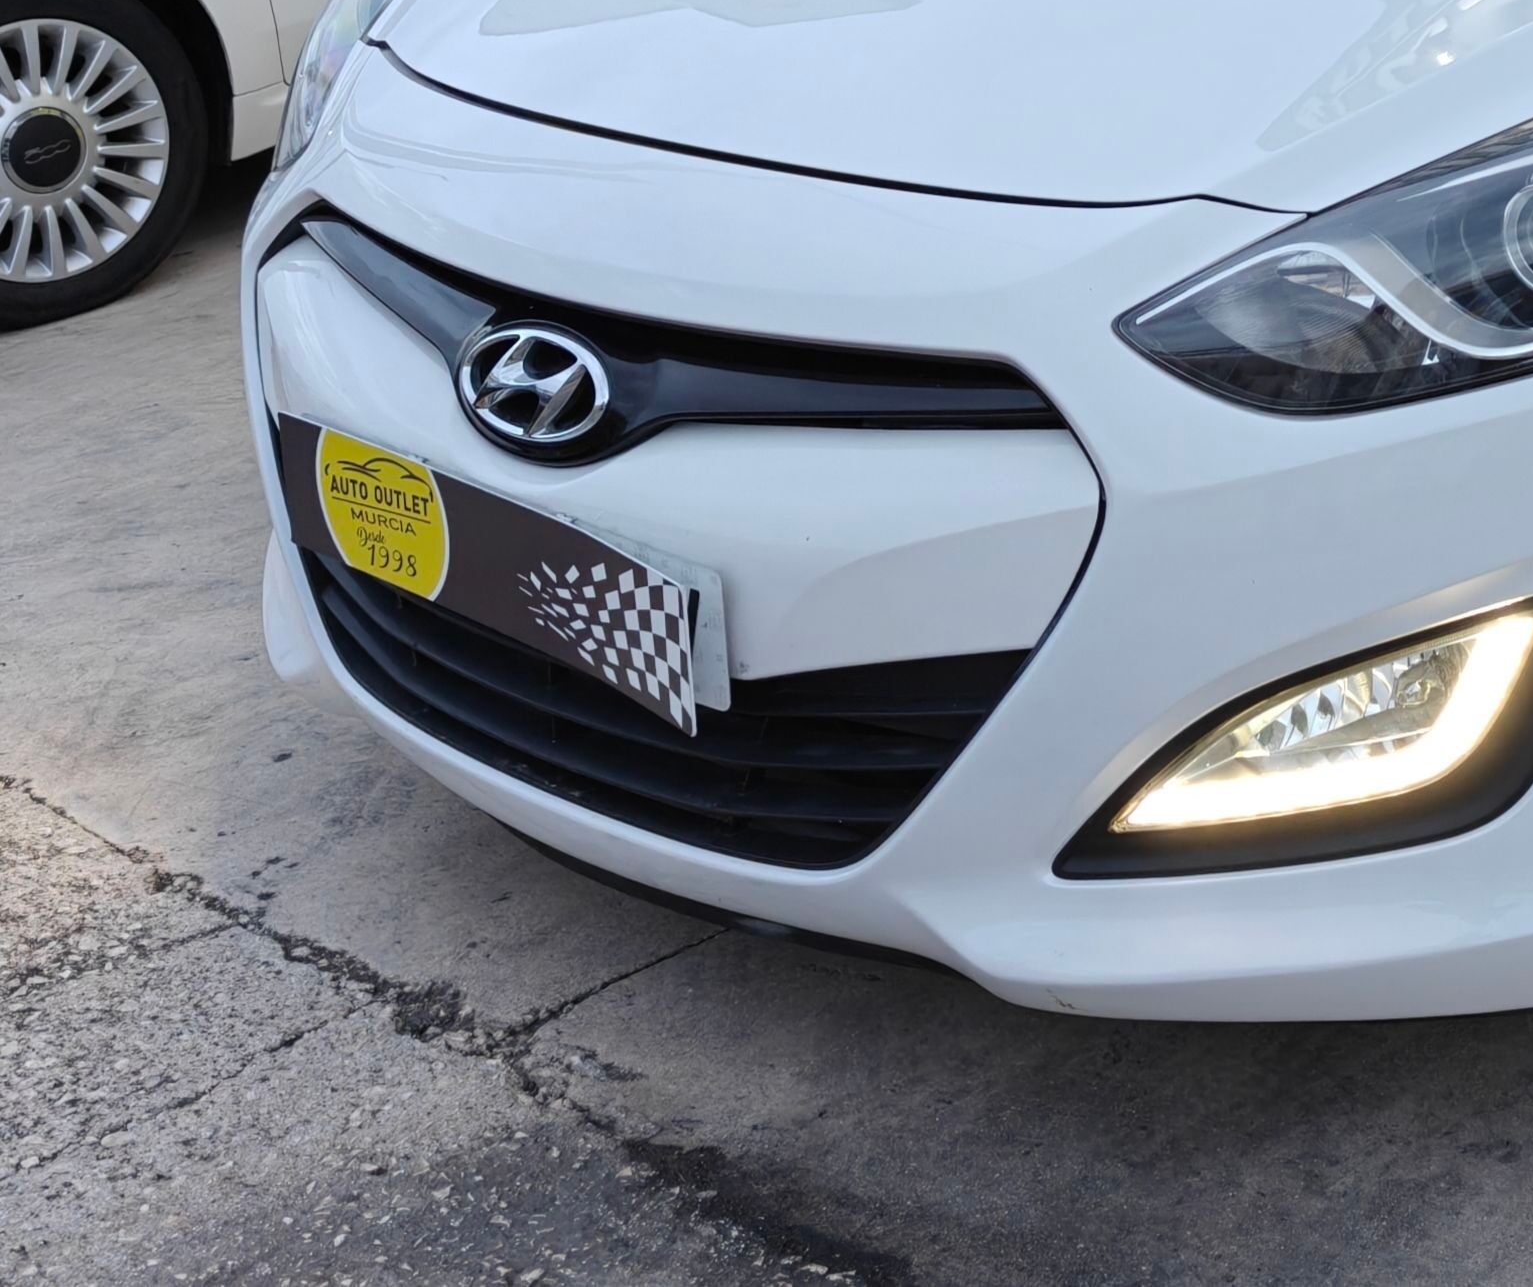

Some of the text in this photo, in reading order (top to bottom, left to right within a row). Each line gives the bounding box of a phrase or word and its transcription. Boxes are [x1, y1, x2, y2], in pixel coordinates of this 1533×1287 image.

[330, 474, 430, 517] AUTO OUTLET
[350, 507, 417, 536] MURCIA
[356, 526, 385, 547] Desde
[367, 544, 417, 577] 1998
